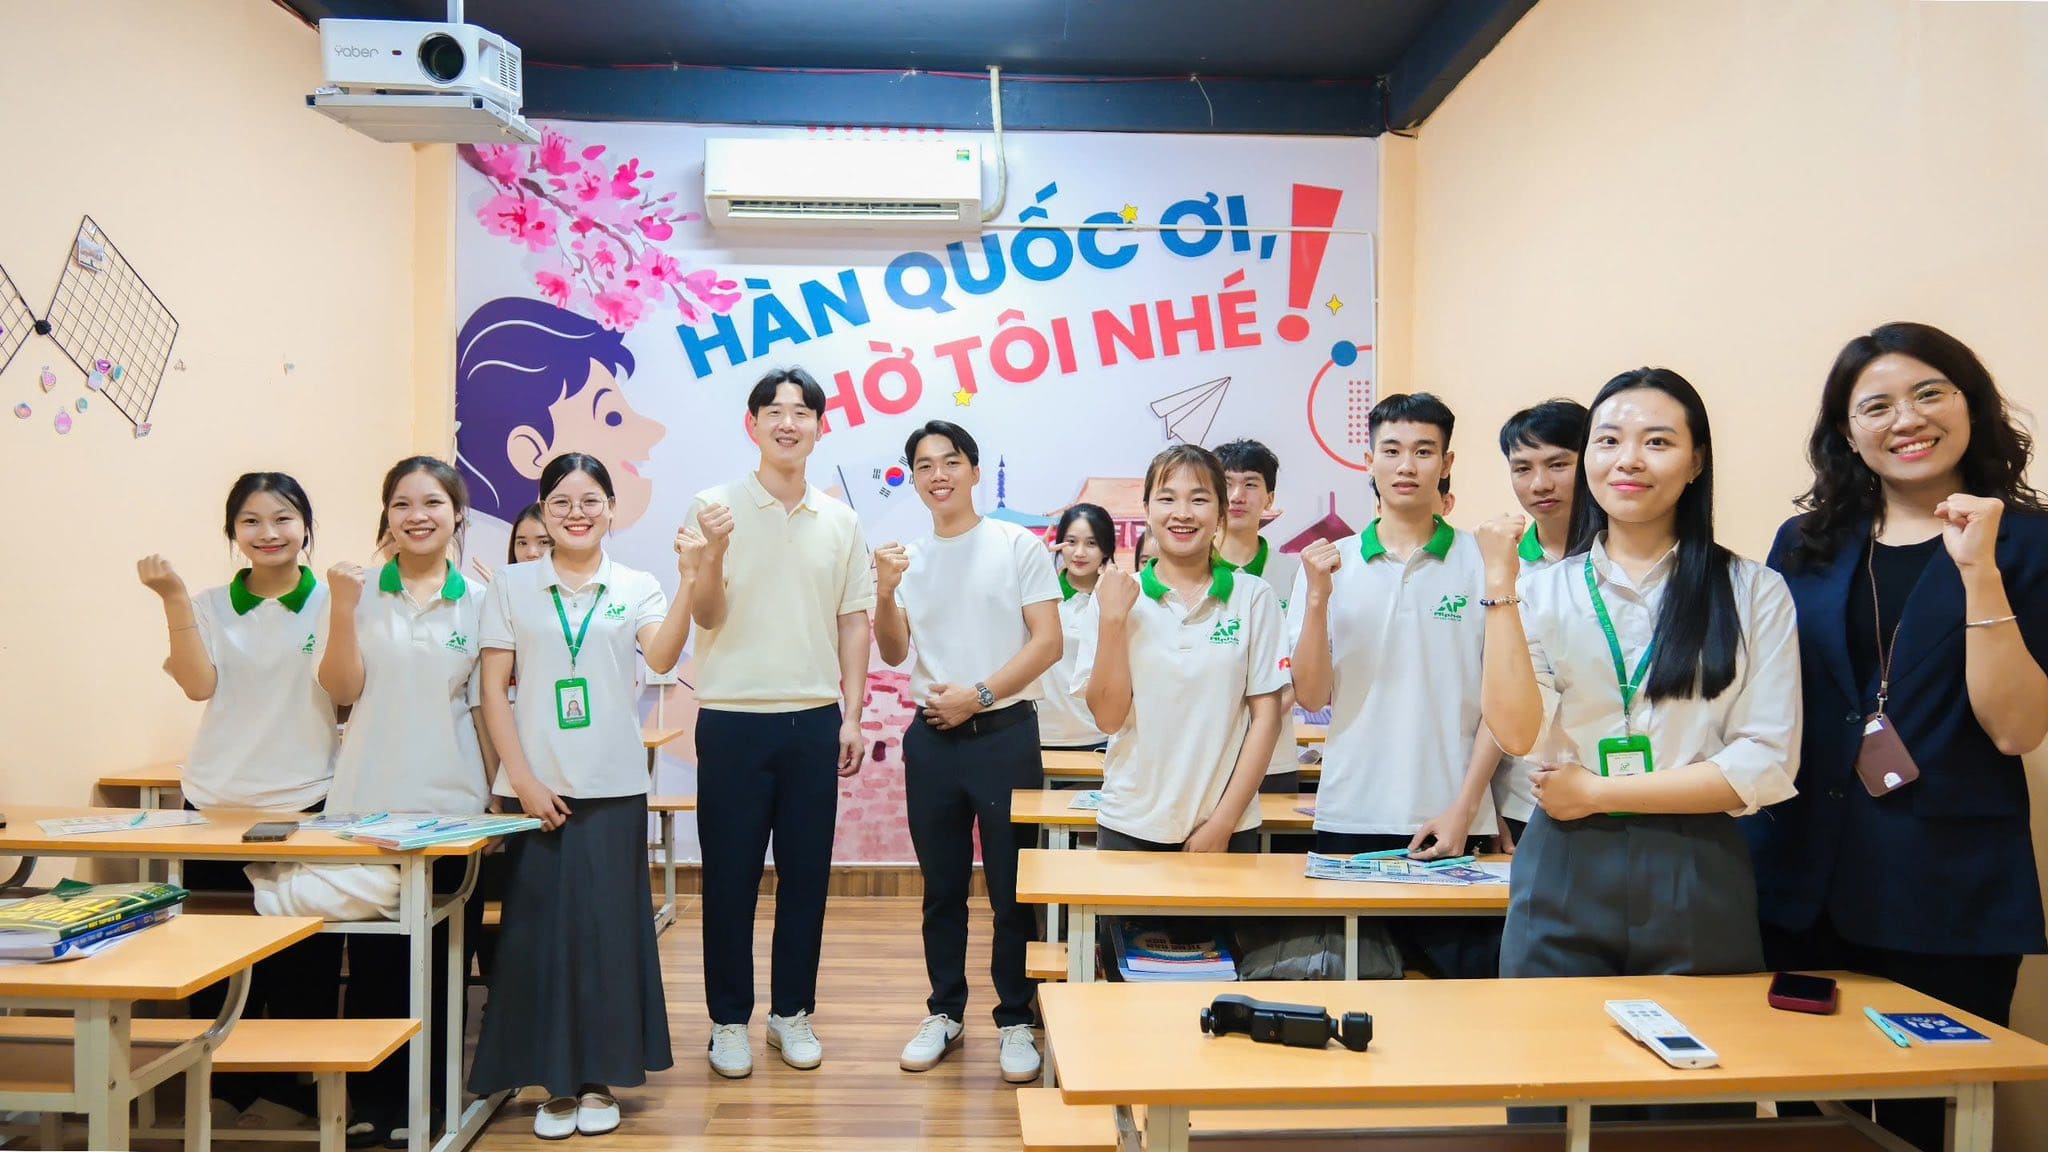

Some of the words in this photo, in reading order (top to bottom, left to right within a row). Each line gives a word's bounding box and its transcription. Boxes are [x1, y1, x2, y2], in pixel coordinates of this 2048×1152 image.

[334, 44, 380, 58] Yaber
[676, 268, 871, 379] HÀN
[884, 181, 1139, 314] QUỐC
[1159, 191, 1277, 260] ƠI,
[744, 340, 923, 446] HỜ
[933, 308, 1078, 395] TÔI
[1437, 594, 1468, 613] AP
